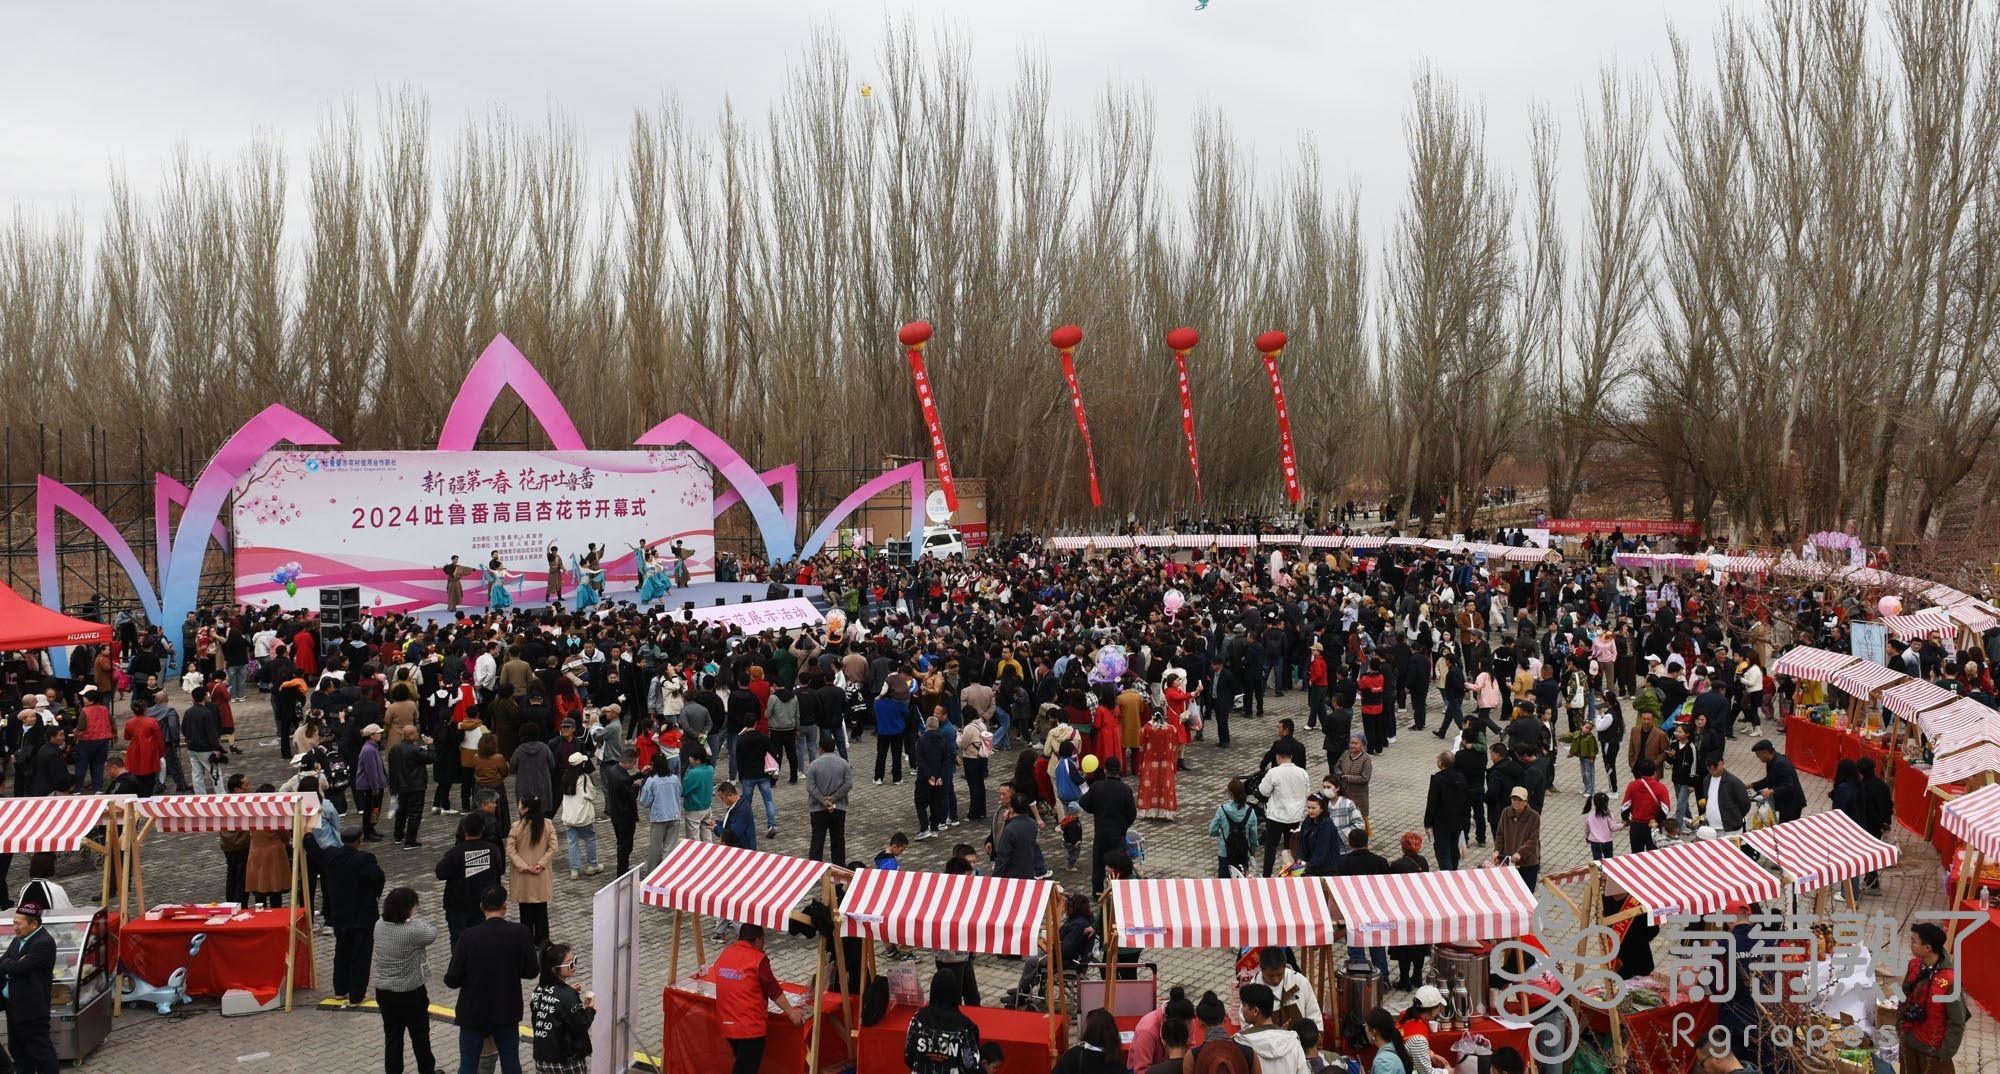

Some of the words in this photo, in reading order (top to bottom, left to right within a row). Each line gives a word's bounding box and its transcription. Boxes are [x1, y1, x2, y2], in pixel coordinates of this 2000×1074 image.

[421, 468, 513, 496] 新疆第一春
[518, 467, 596, 492] 花开吐鲁番
[351, 497, 647, 529] 2024吐鲁番高昌杏花节开幕式
[67, 632, 100, 640] HUAWEI
